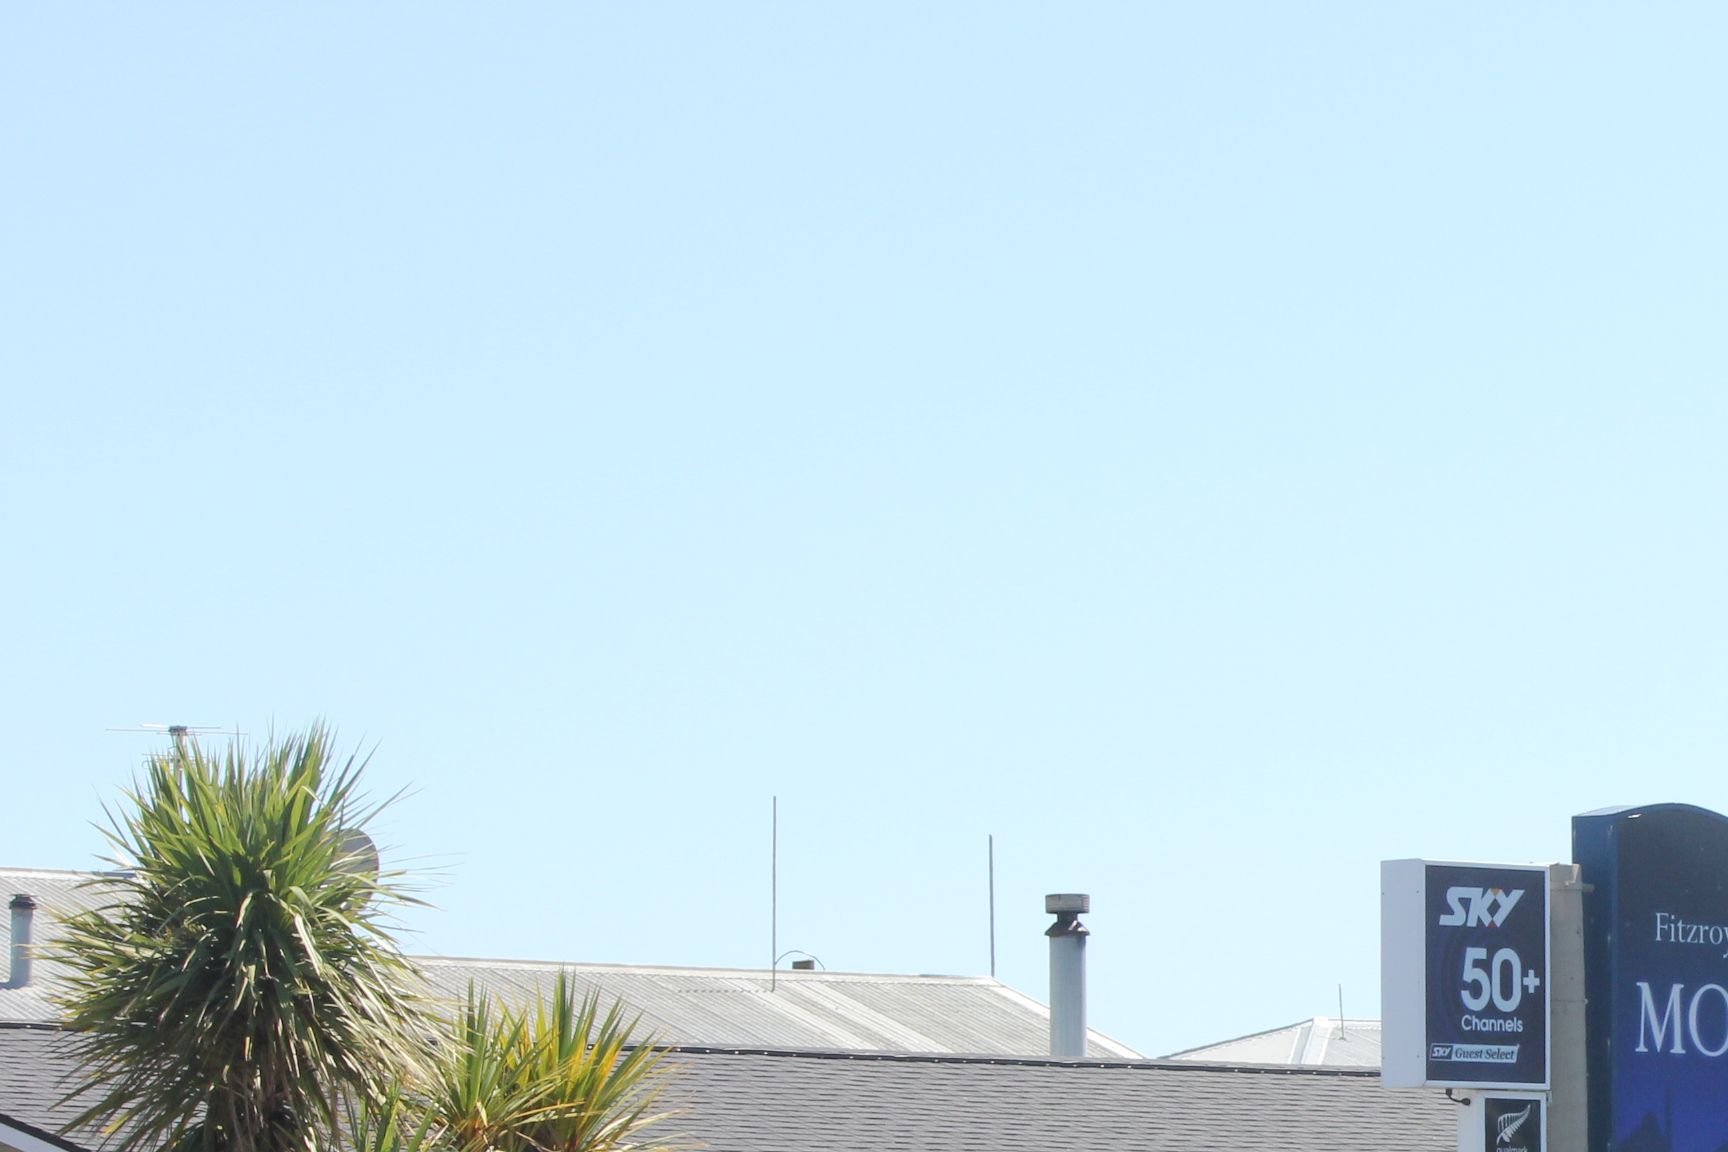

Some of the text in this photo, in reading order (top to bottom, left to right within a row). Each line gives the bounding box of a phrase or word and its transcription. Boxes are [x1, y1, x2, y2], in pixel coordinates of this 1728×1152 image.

[1439, 886, 1525, 928] SKY
[1460, 946, 1541, 1013] 50+
[1461, 1014, 1524, 1033] Channels
[1432, 1046, 1514, 1060] SKY Guest Select
